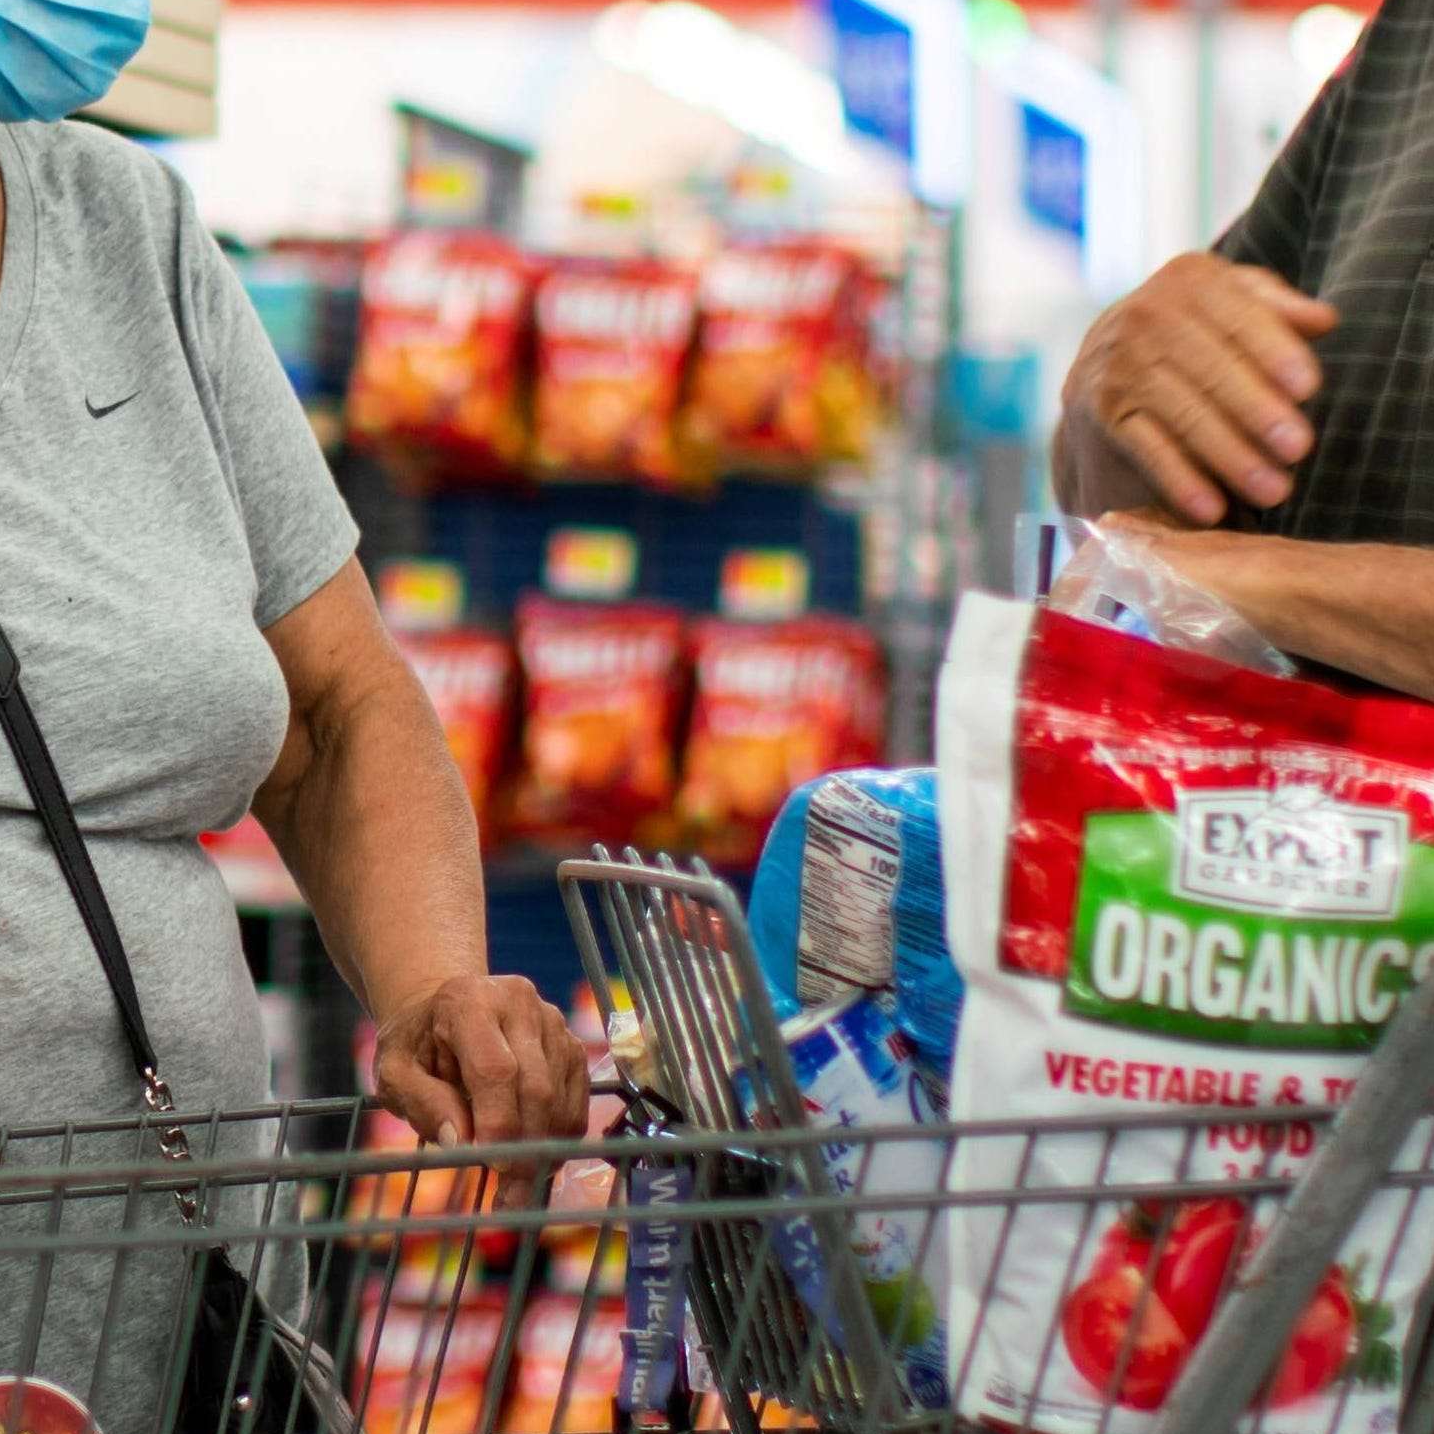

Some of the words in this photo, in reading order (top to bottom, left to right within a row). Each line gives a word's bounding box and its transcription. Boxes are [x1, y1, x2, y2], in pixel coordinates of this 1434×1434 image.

[869, 856, 898, 880] 100
[1044, 1050, 1258, 1108] VEGETABLE
[1274, 1078, 1305, 1108] &
